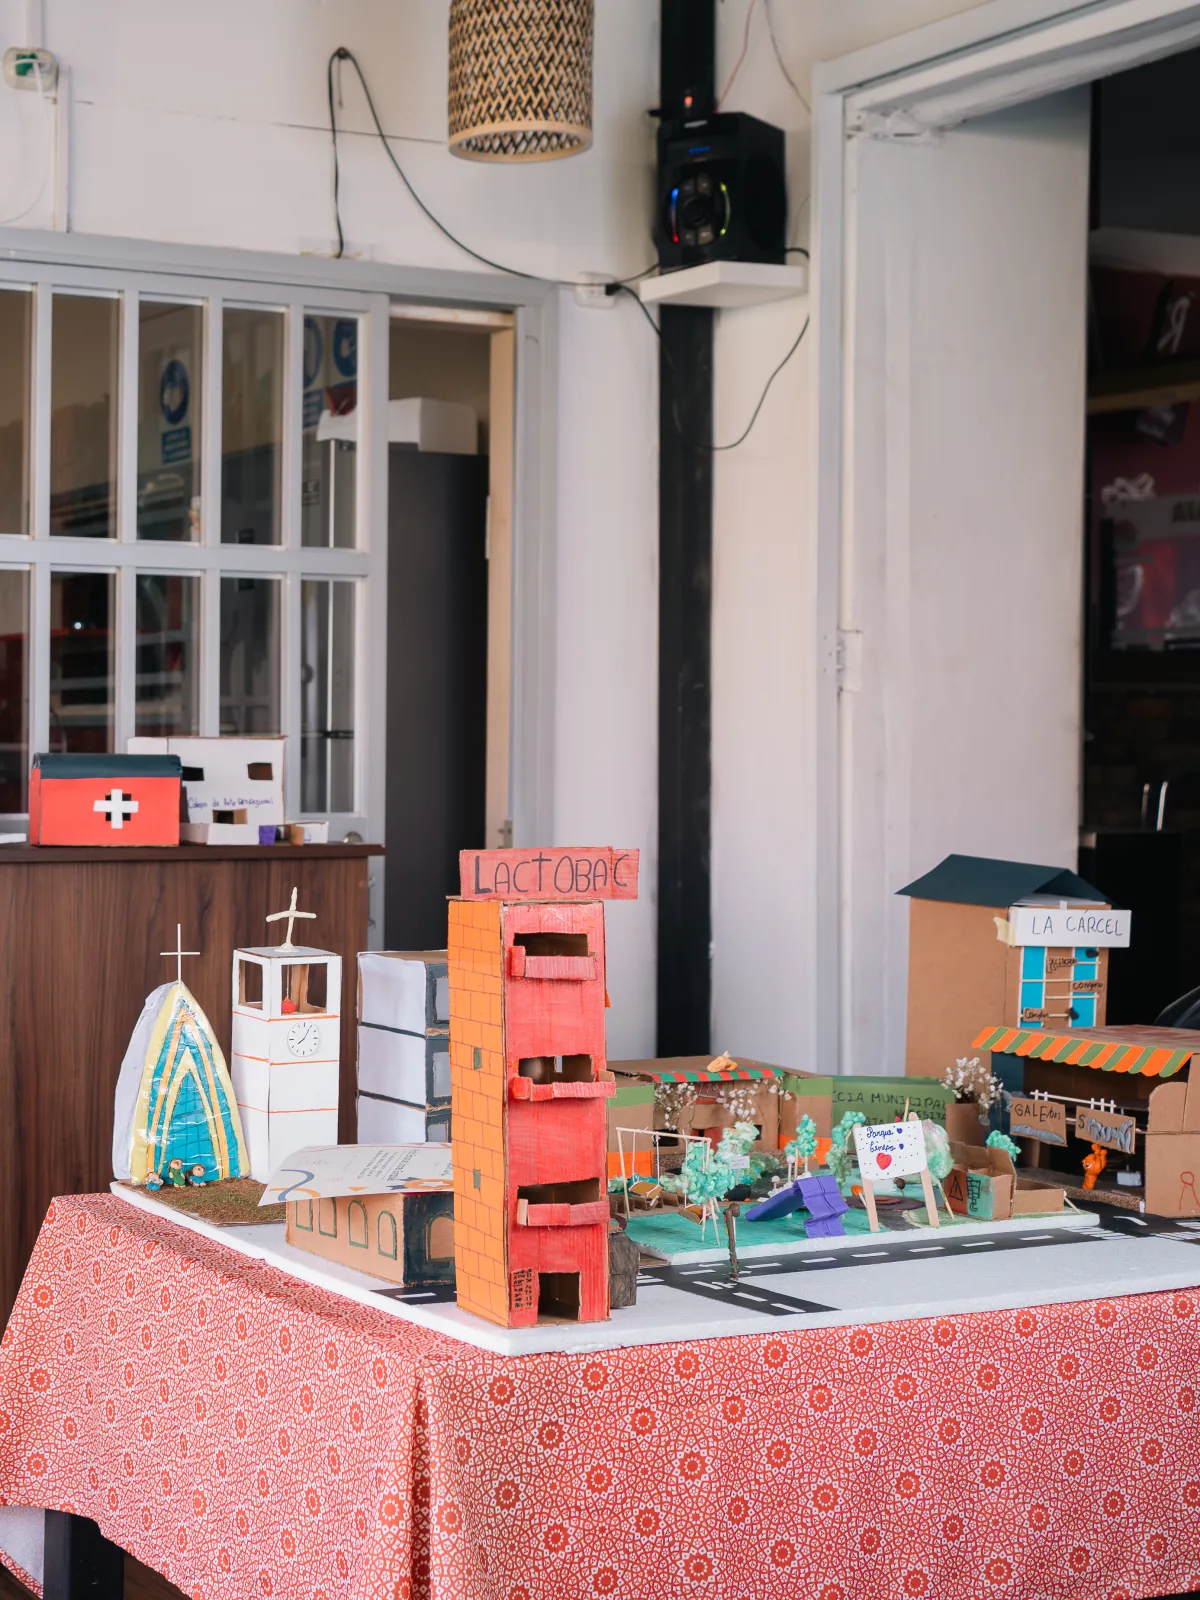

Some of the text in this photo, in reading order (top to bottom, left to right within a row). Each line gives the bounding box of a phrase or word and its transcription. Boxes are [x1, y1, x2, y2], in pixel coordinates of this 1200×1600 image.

[475, 852, 629, 894] LACTOBAC
[1032, 909, 1123, 936] LA CÁRCEL
[866, 1126, 894, 1140] Parque
